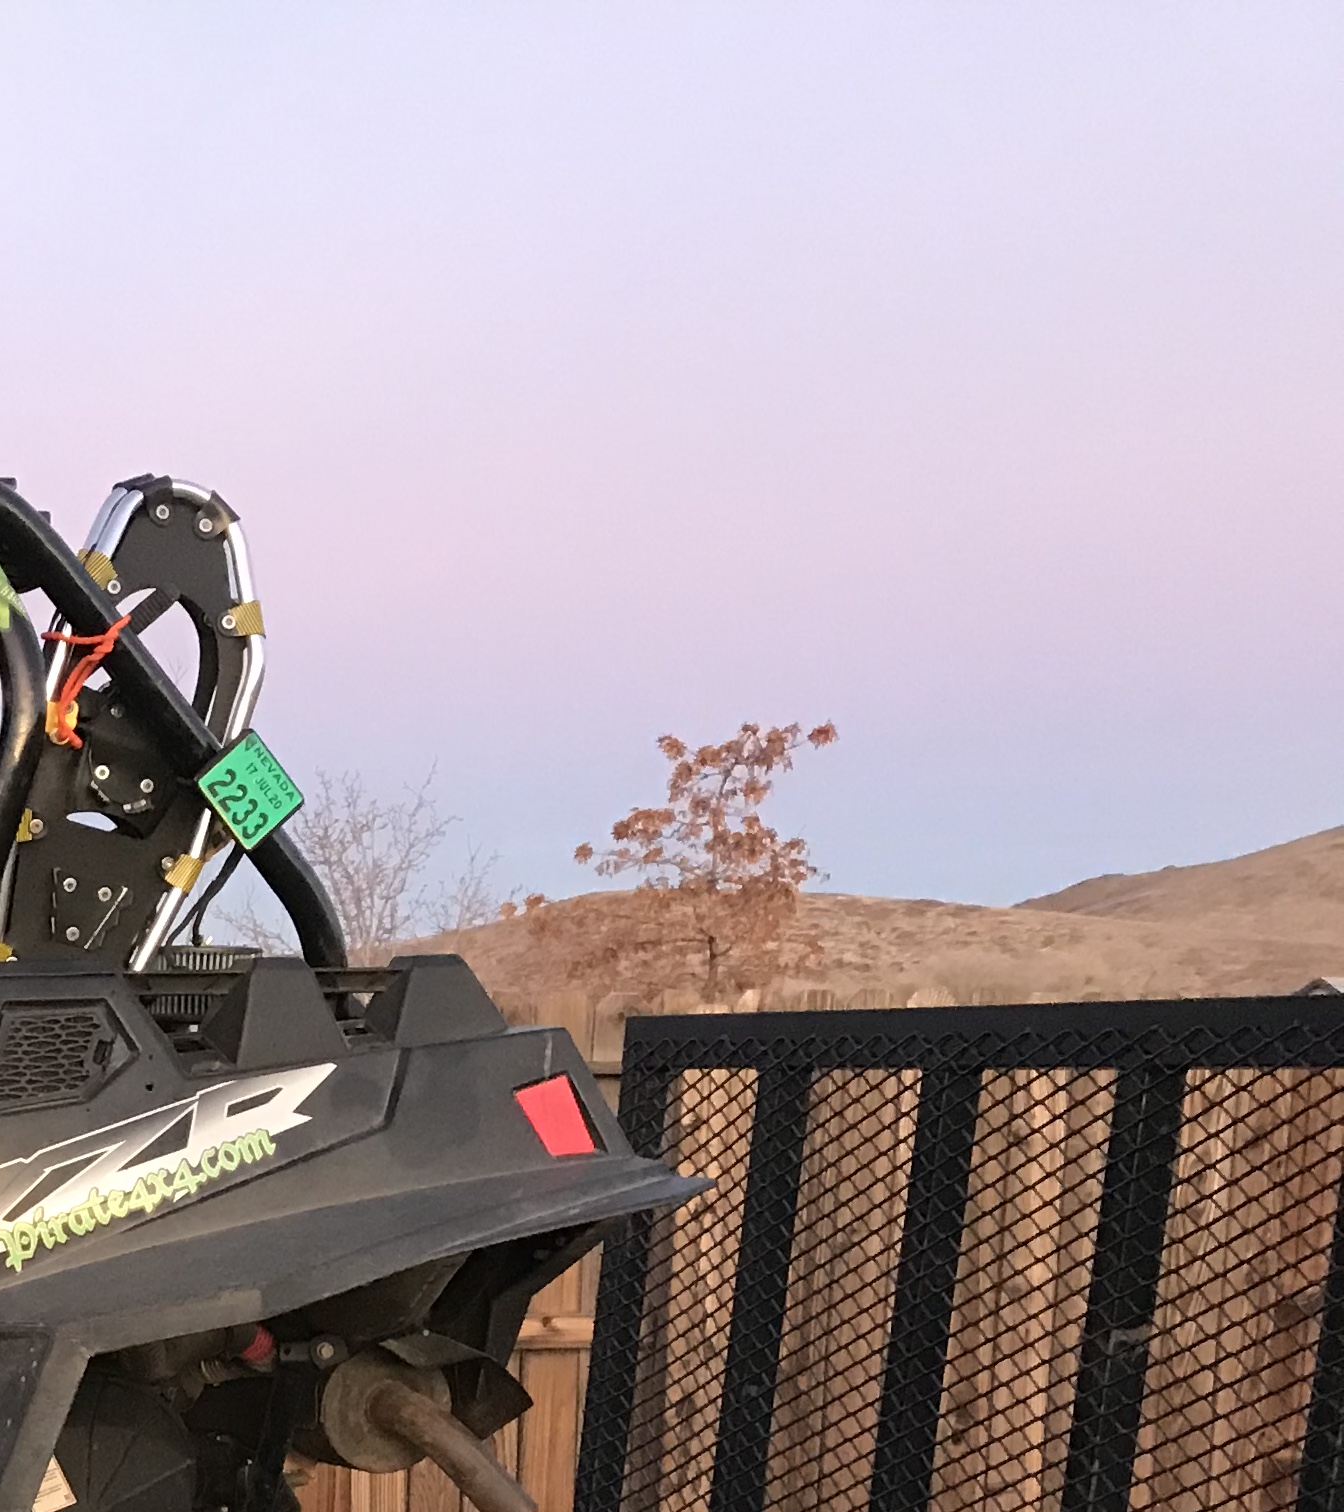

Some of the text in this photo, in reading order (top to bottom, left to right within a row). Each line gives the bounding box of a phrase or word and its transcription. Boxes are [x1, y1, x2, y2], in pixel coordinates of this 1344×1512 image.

[245, 762, 258, 775] 17
[253, 746, 295, 802] NEVADA
[207, 768, 269, 839] 2233
